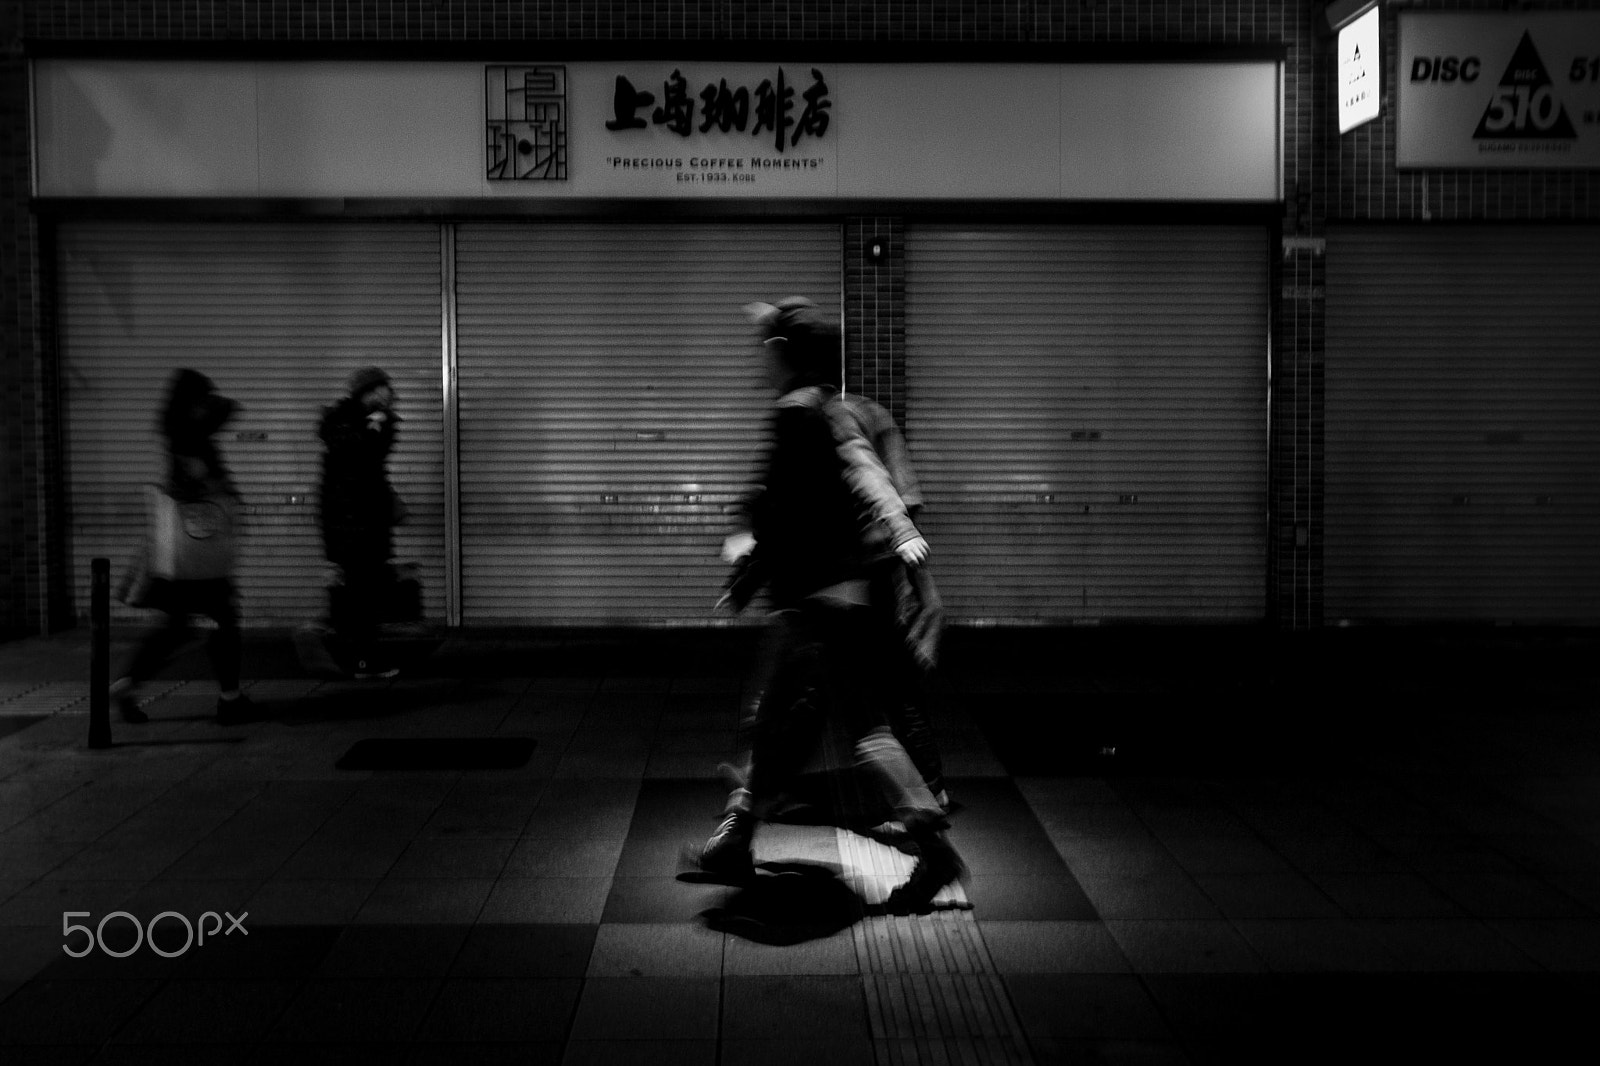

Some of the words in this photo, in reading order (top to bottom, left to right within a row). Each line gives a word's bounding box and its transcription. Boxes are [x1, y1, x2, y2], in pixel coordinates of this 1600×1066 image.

[1411, 56, 1481, 82] DISC
[605, 65, 832, 153] 上島珈琲店
[1484, 82, 1562, 133] 510
[690, 157, 744, 168] COFFEE
